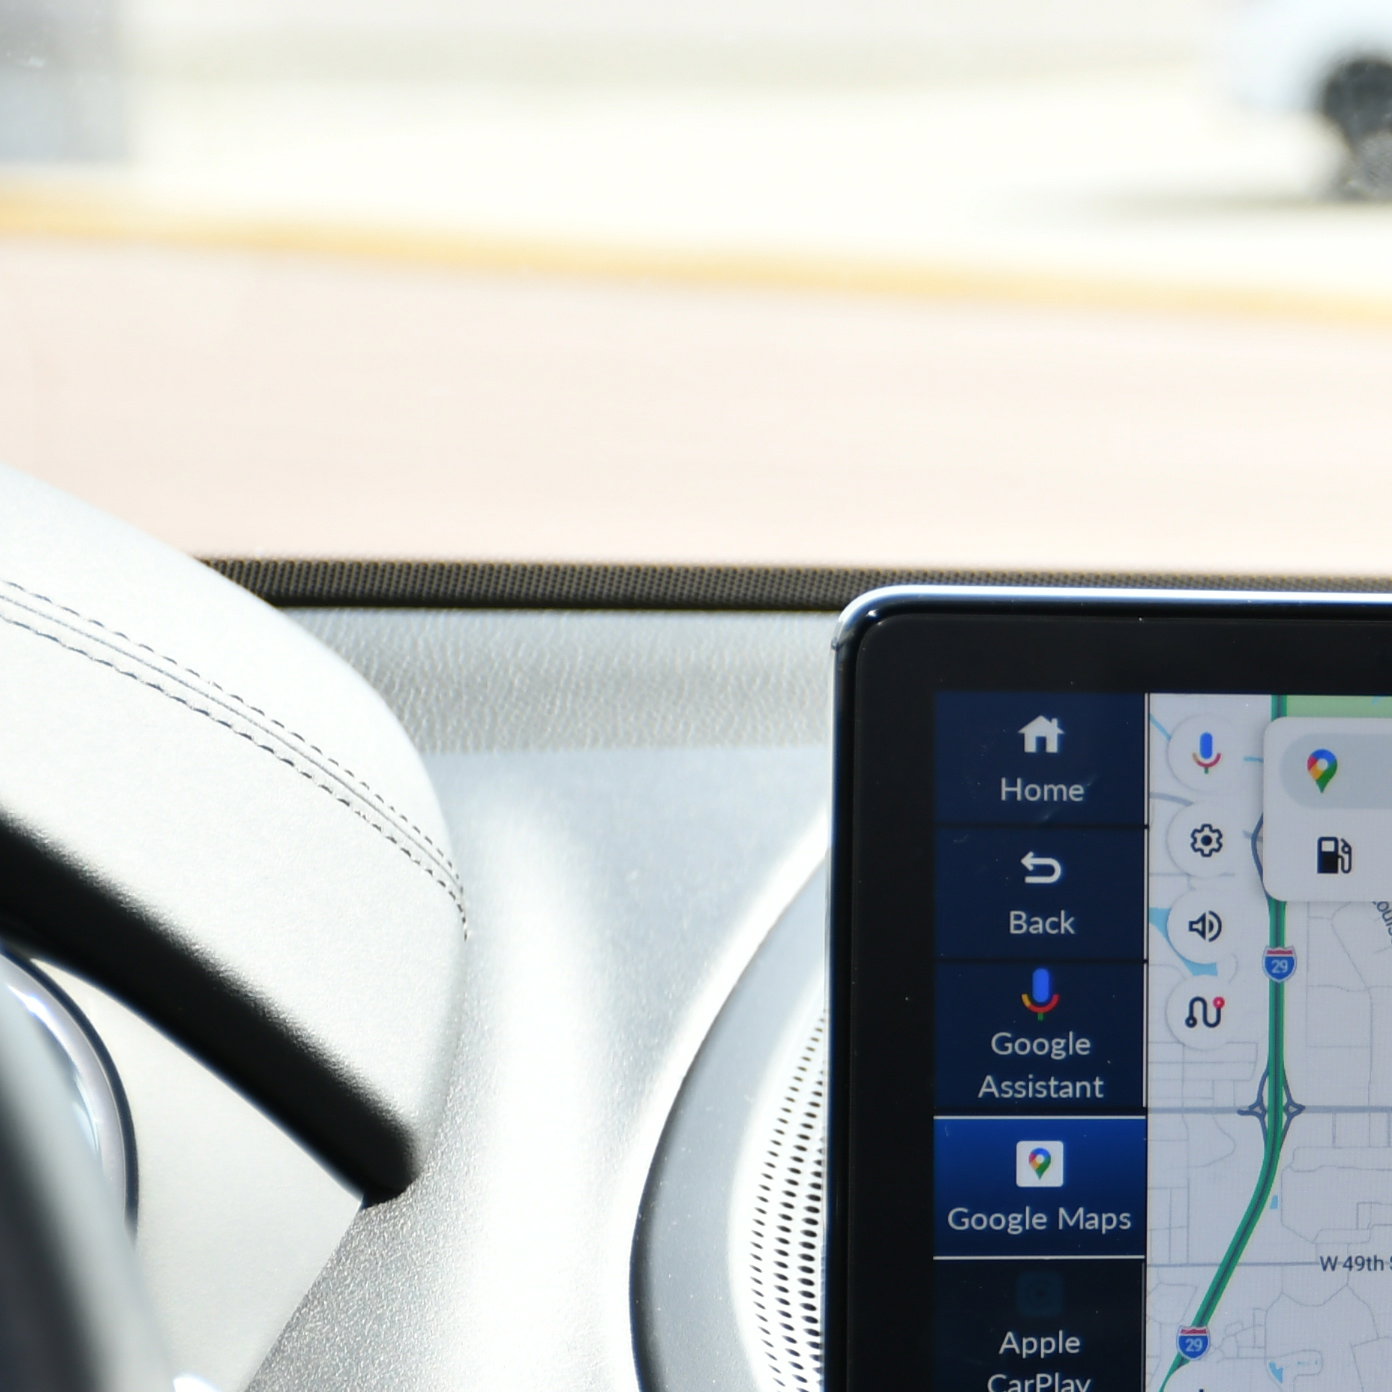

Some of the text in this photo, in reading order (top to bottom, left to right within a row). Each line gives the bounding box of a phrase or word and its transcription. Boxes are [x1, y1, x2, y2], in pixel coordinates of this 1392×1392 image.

[1000, 777, 1085, 801] Home
[1008, 909, 1076, 935] Back
[1271, 959, 1289, 973] 29
[990, 1032, 1091, 1060] Google
[978, 1074, 1104, 1100] Assistant
[947, 1206, 1131, 1235] Google Maps
[1320, 1255, 1338, 1272] W
[1342, 1255, 1385, 1272] 49th
[998, 1330, 1081, 1358] Apple
[1184, 1338, 1203, 1352] 29
